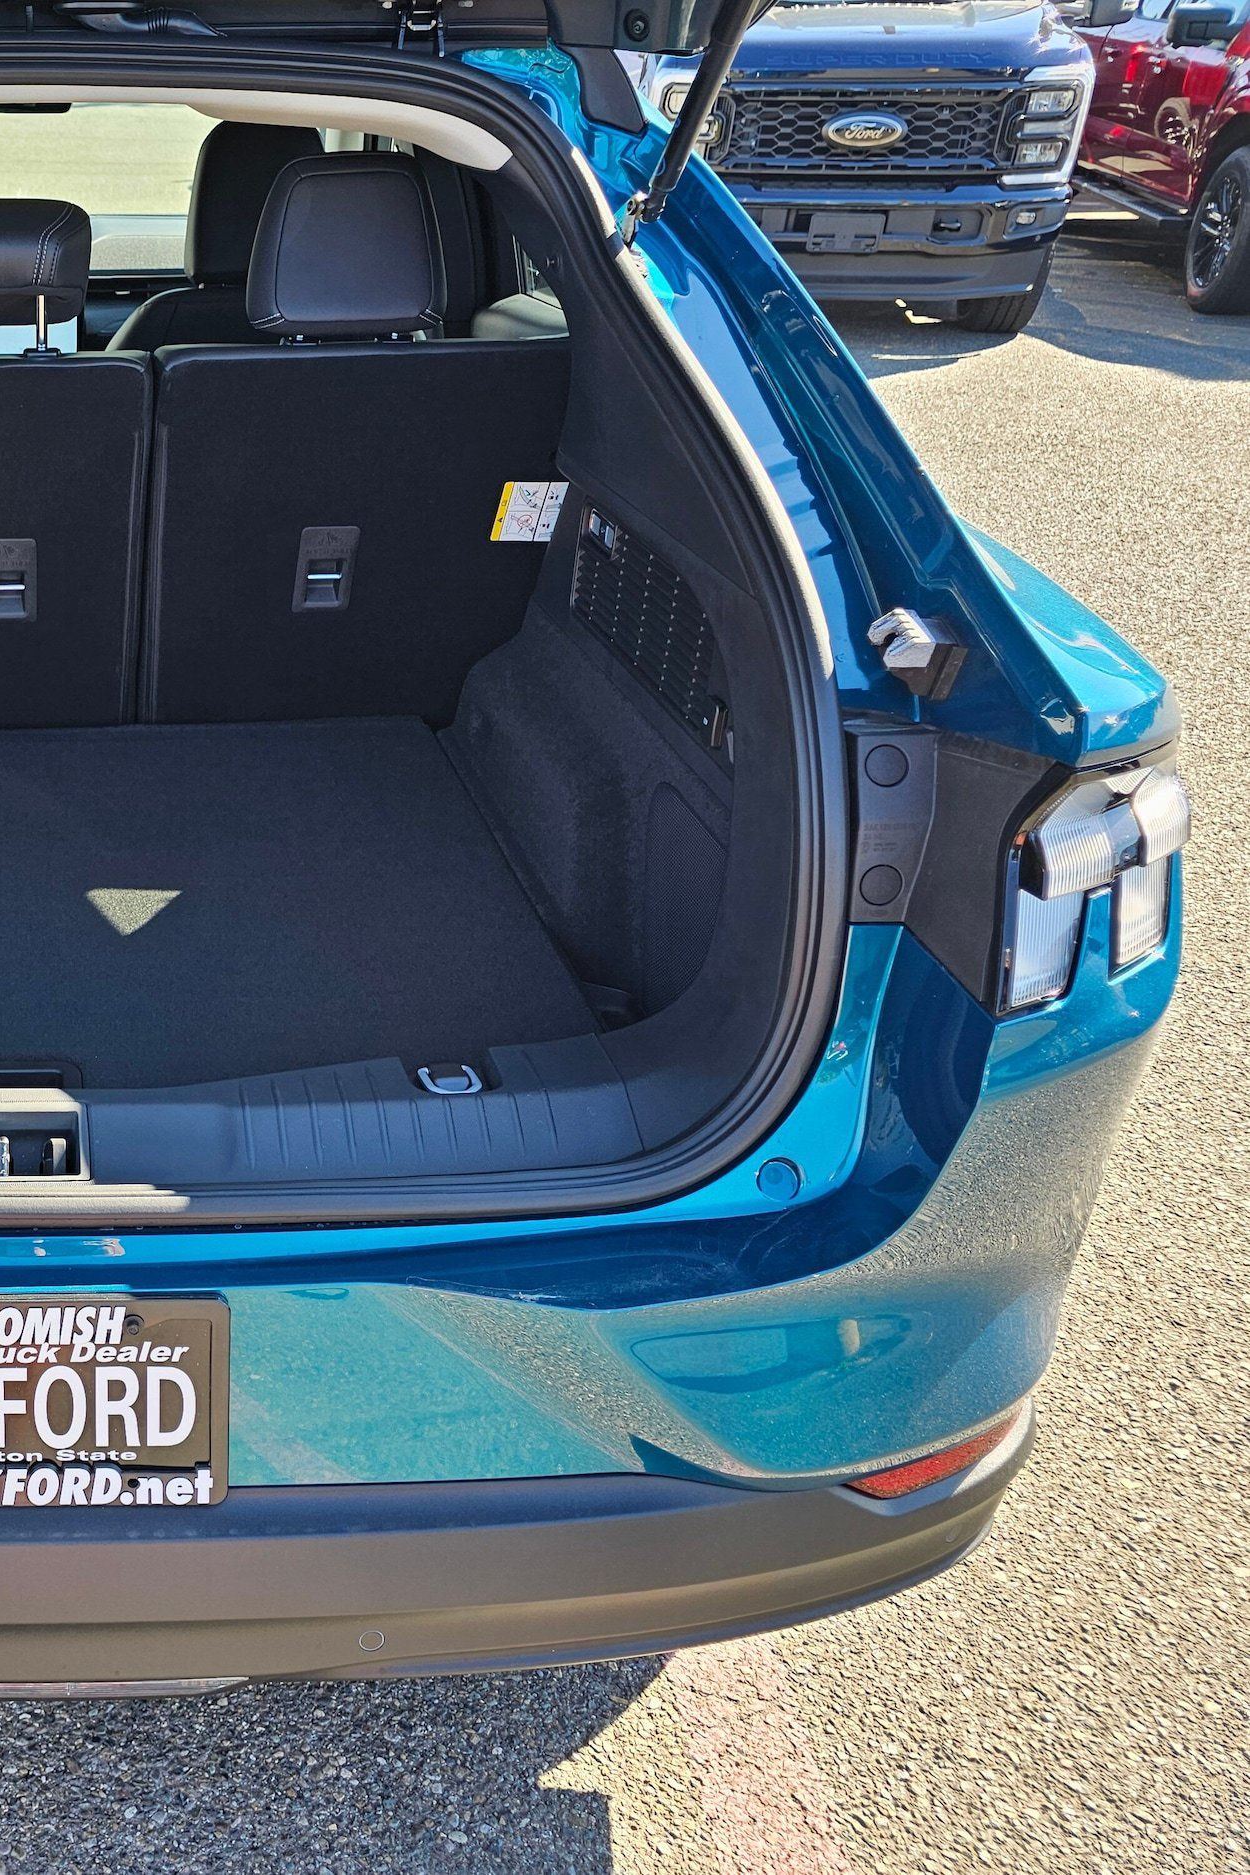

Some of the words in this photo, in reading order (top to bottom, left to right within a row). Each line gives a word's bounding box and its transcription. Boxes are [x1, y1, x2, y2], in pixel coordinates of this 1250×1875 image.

[895, 52, 992, 65] DUTY
[844, 121, 886, 140] Ford
[69, 1341, 190, 1363] Dealer
[55, 1449, 138, 1463] State
